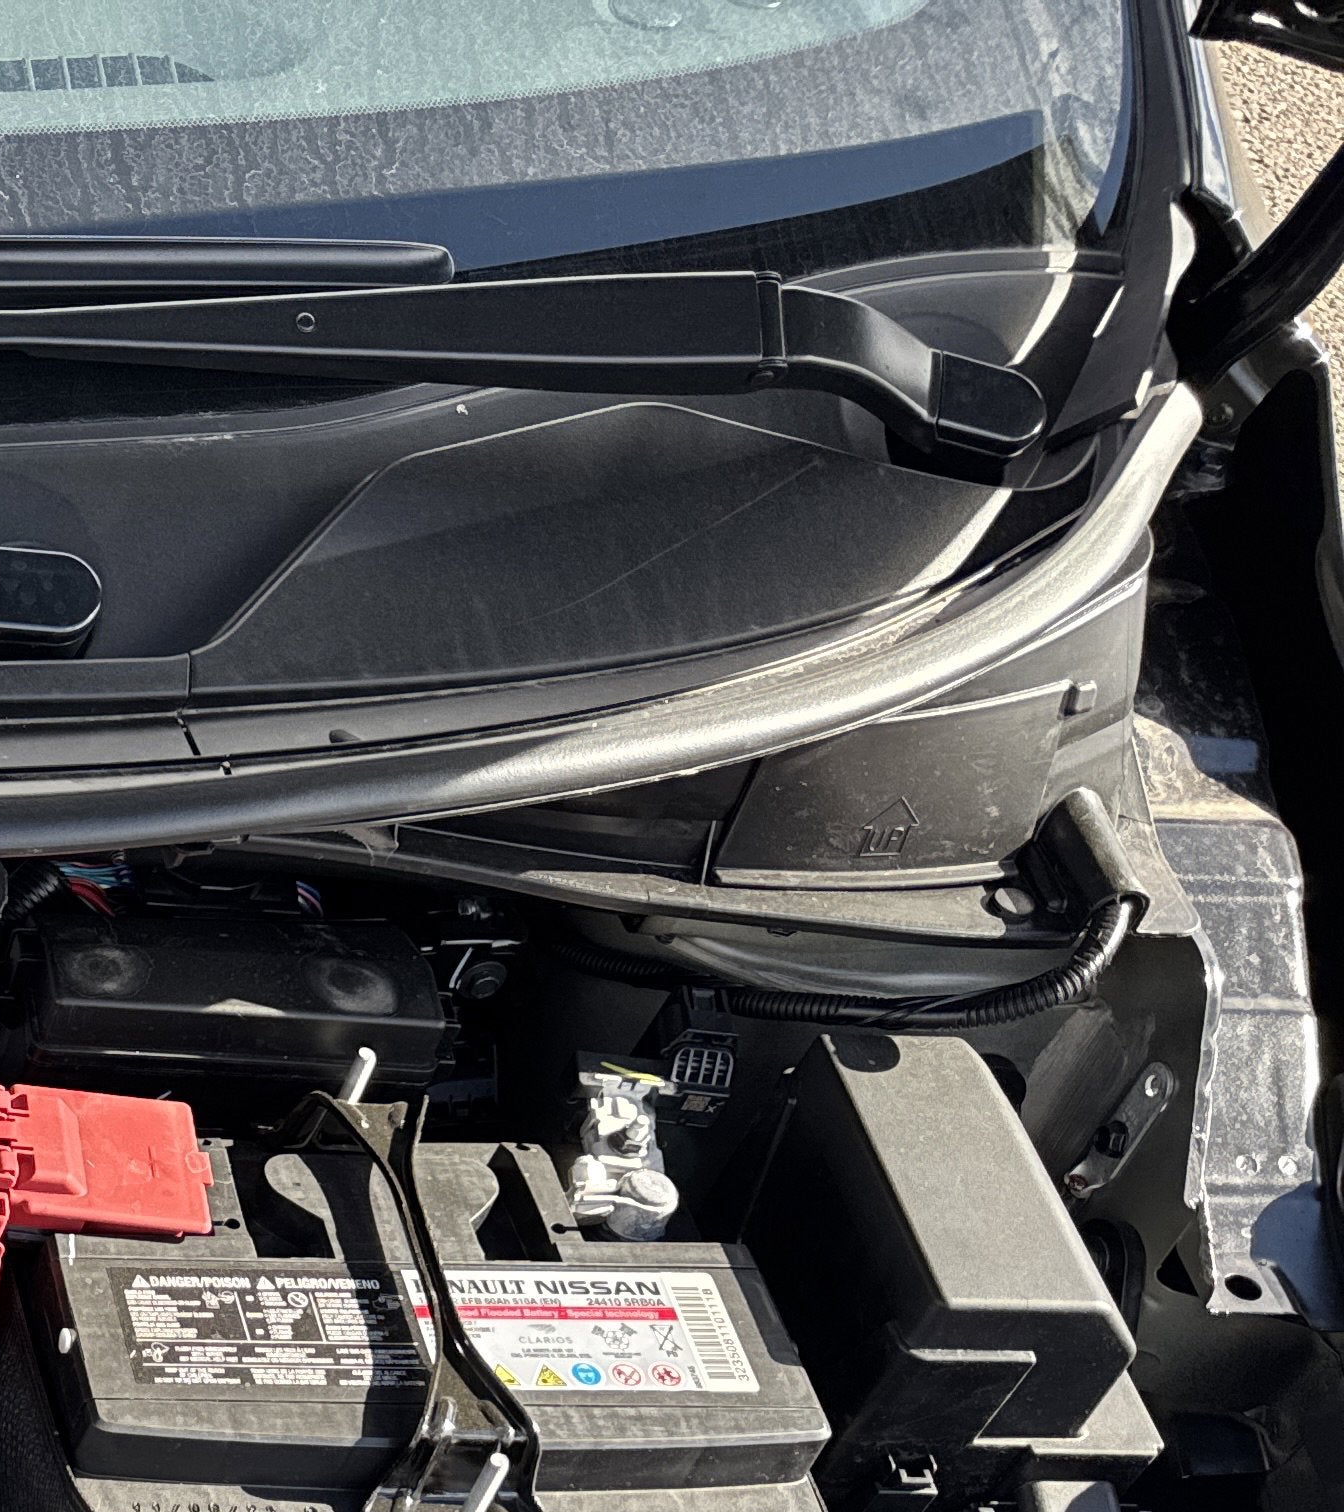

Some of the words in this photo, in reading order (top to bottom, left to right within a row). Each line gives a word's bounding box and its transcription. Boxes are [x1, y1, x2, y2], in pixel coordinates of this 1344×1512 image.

[149, 1276, 251, 1288] DANGER/POISON
[275, 1277, 380, 1289] PELIGRO/VENENO
[534, 1280, 661, 1296] NISSAN
[518, 1336, 574, 1344] CLARIOS
